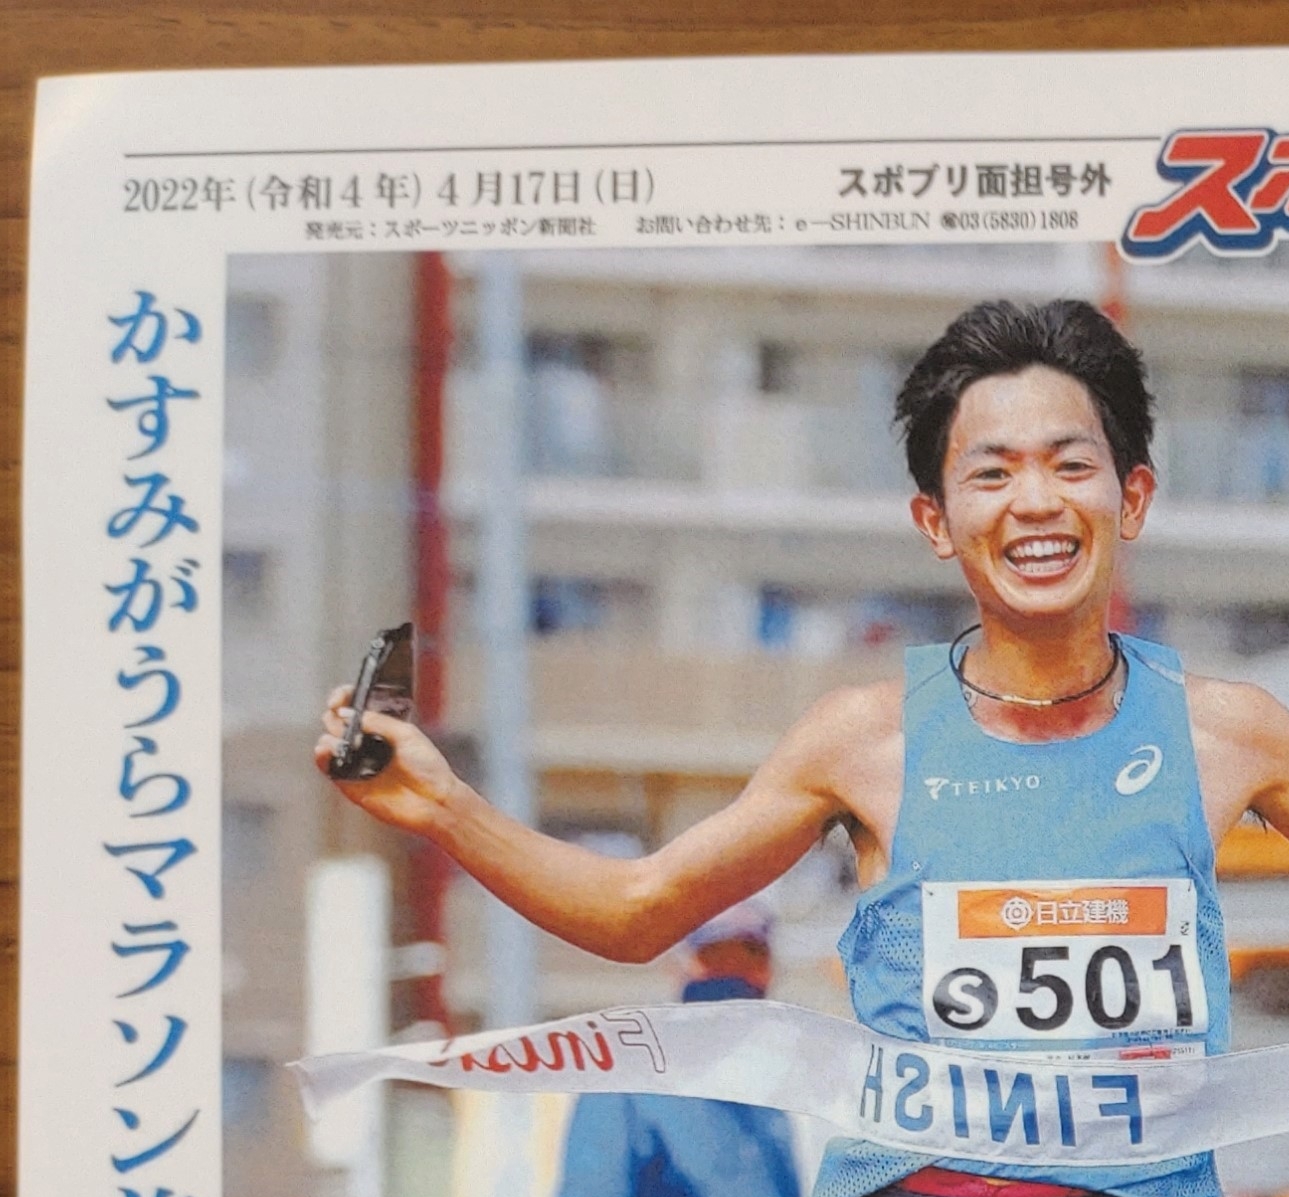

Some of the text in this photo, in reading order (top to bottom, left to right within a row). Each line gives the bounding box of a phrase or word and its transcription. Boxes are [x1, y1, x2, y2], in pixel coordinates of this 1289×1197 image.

[839, 162, 1112, 199] スポプリ面担号外
[952, 774, 1042, 796] TEIKYO
[1035, 899, 1129, 926] 日立建機
[1015, 944, 1195, 1032] 501
